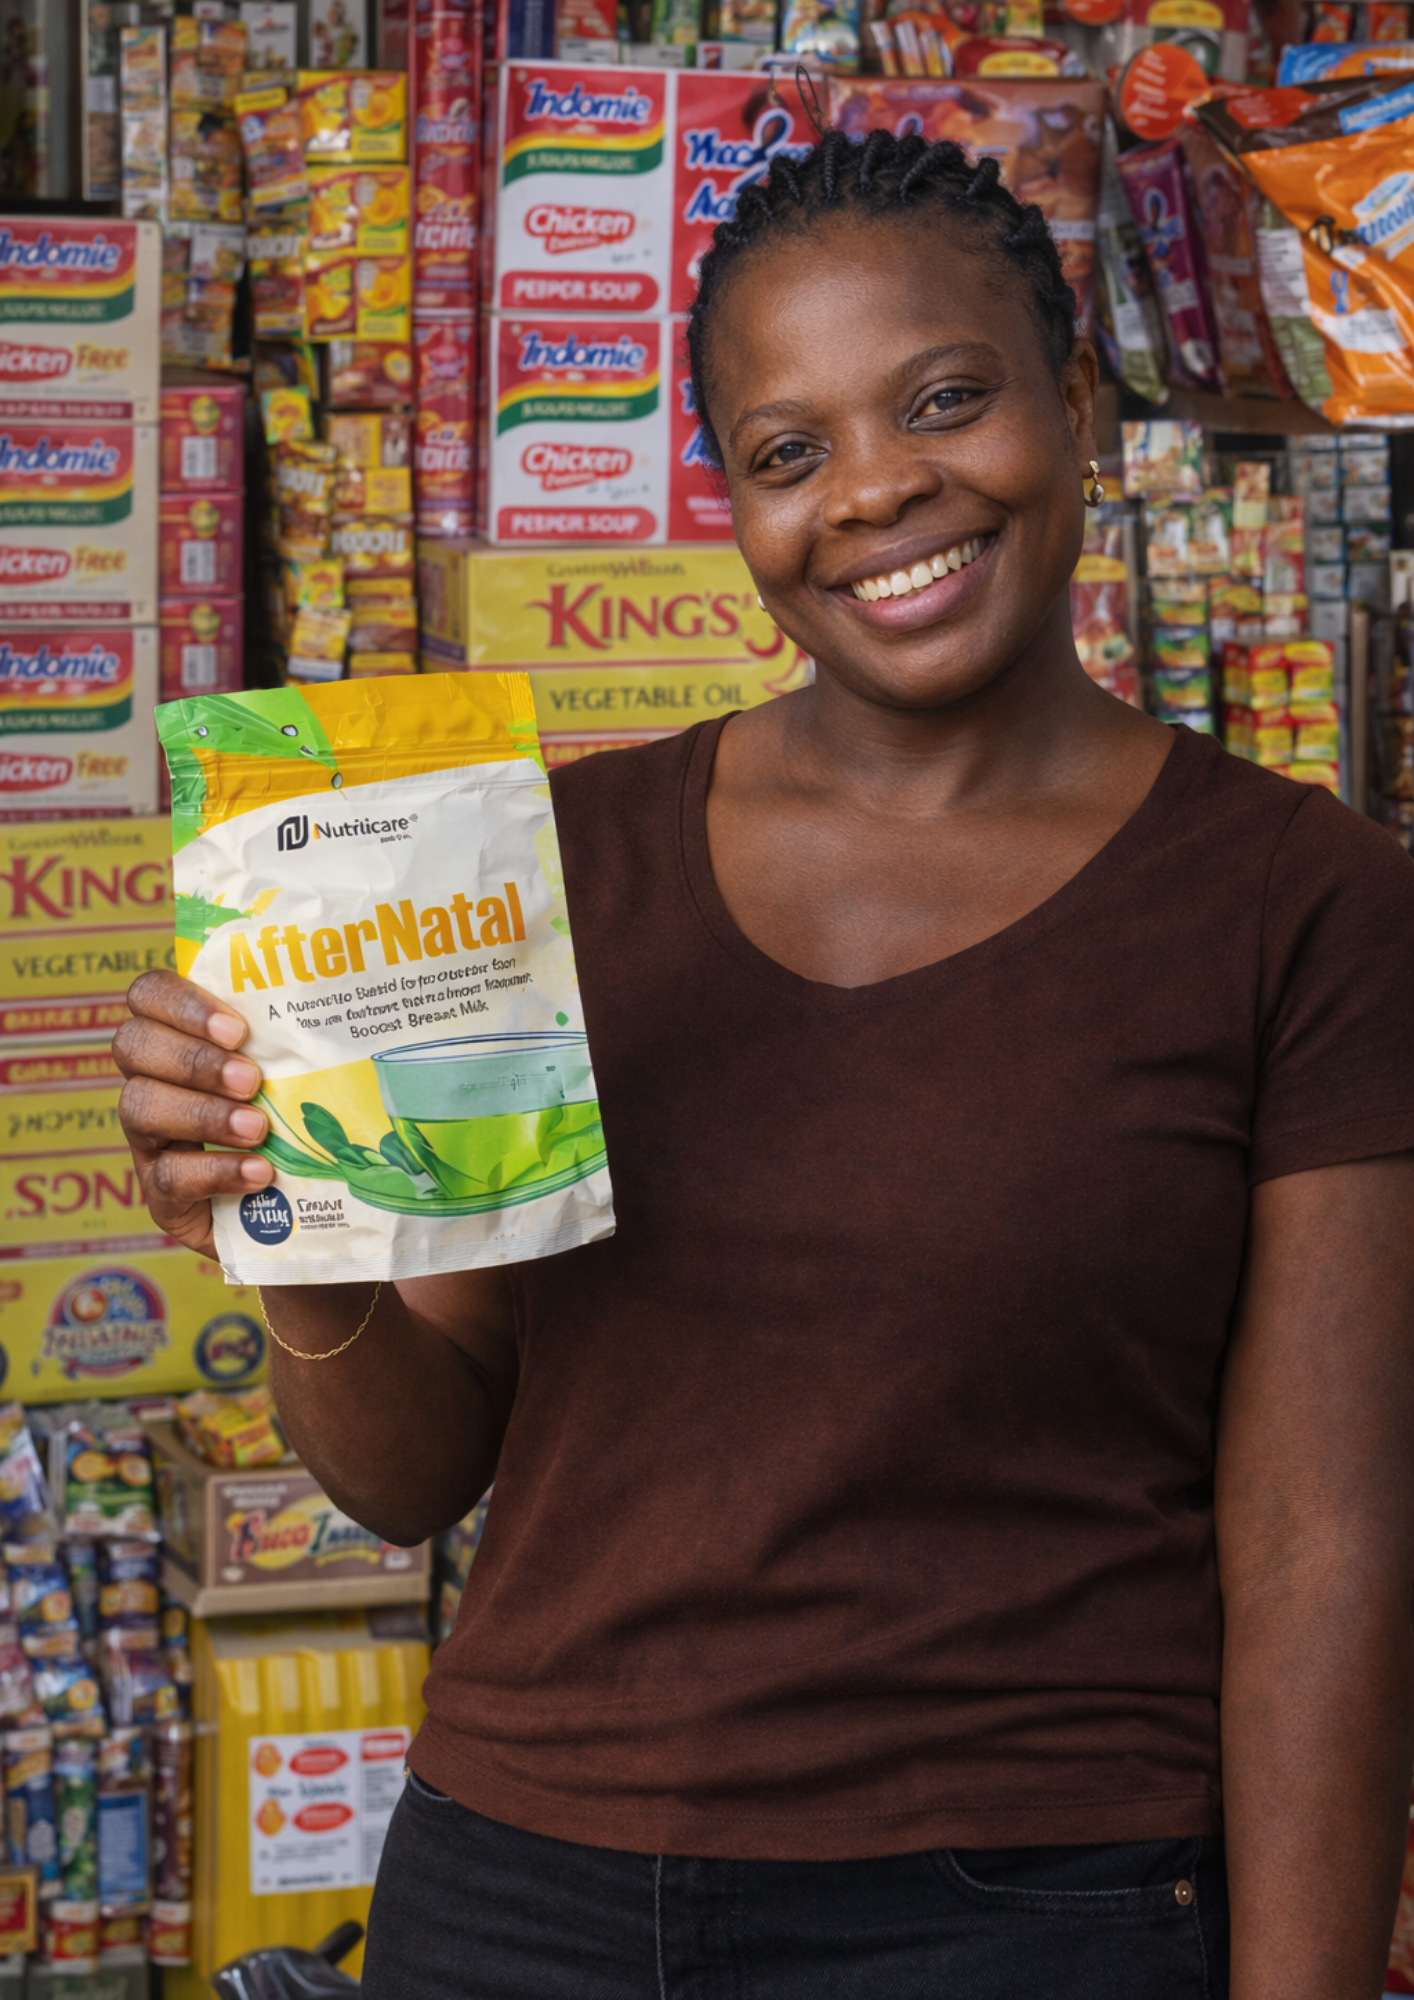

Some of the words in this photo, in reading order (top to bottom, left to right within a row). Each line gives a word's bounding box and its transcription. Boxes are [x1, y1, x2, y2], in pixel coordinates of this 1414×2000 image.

[525, 78, 652, 125] Indomie
[527, 206, 632, 237] Chicken
[74, 342, 131, 371] Free
[518, 330, 648, 373] Indomie
[525, 444, 629, 474] Chicken
[549, 685, 696, 712] VEGETABLE
[703, 683, 747, 707] OIL
[229, 882, 526, 994] AfterNatal
[12, 951, 161, 980] VEGETABLE
[268, 1003, 282, 1022] A
